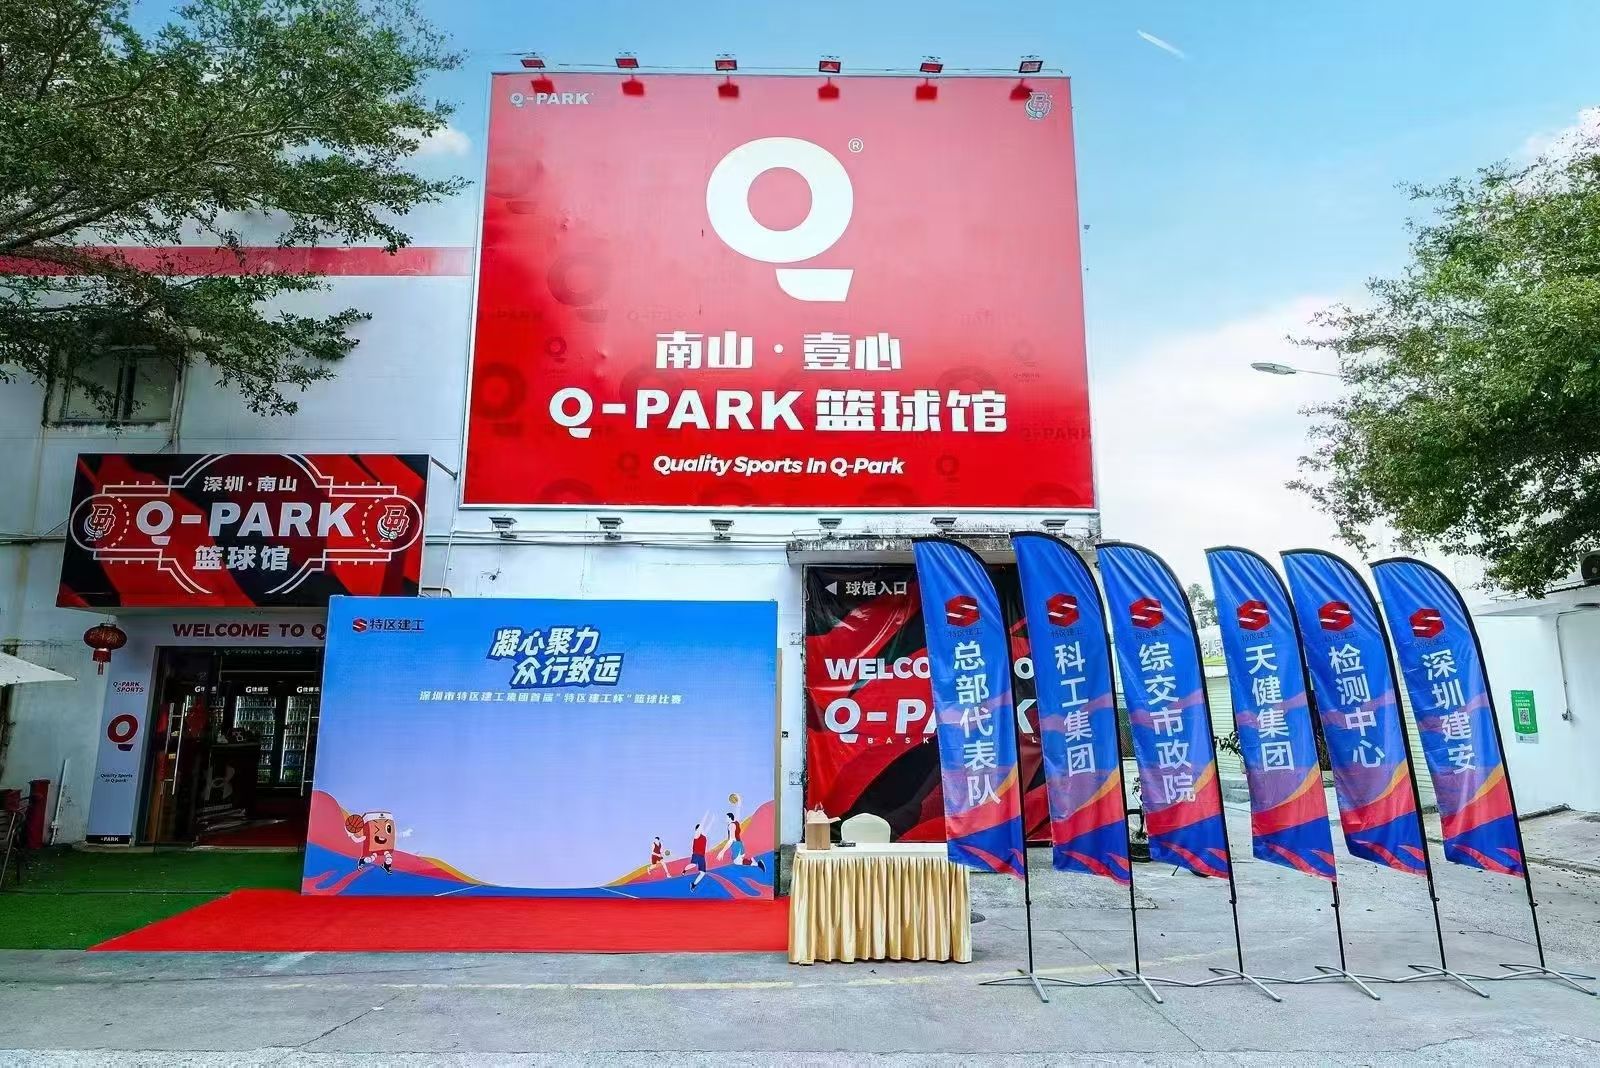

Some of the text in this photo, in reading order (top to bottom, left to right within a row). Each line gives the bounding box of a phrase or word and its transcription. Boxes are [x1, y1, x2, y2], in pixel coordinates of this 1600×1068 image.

[510, 92, 590, 107] Q-PARK
[549, 387, 1007, 438] Q-PARK 篮球馆
[653, 454, 906, 477] Quality Sports In Q-Park
[203, 476, 298, 492] 深圳·南山
[136, 501, 353, 544] Q-PARK
[193, 545, 291, 571] 篮球馆
[846, 580, 907, 596] 球馆入口
[172, 623, 270, 638] WELCOME
[278, 623, 305, 638] TO
[369, 618, 425, 631] 特区建工
[490, 626, 600, 657] 凝心聚力
[512, 655, 622, 685] 众行致远
[825, 657, 931, 680] WELCO
[1054, 641, 1096, 776] 科工集团
[1245, 643, 1295, 772] 天健集团
[1328, 643, 1385, 769] 检测中心
[1422, 649, 1476, 775] 深圳建安
[953, 641, 1001, 807] 总部代表队
[1139, 642, 1196, 804] 综交市政院
